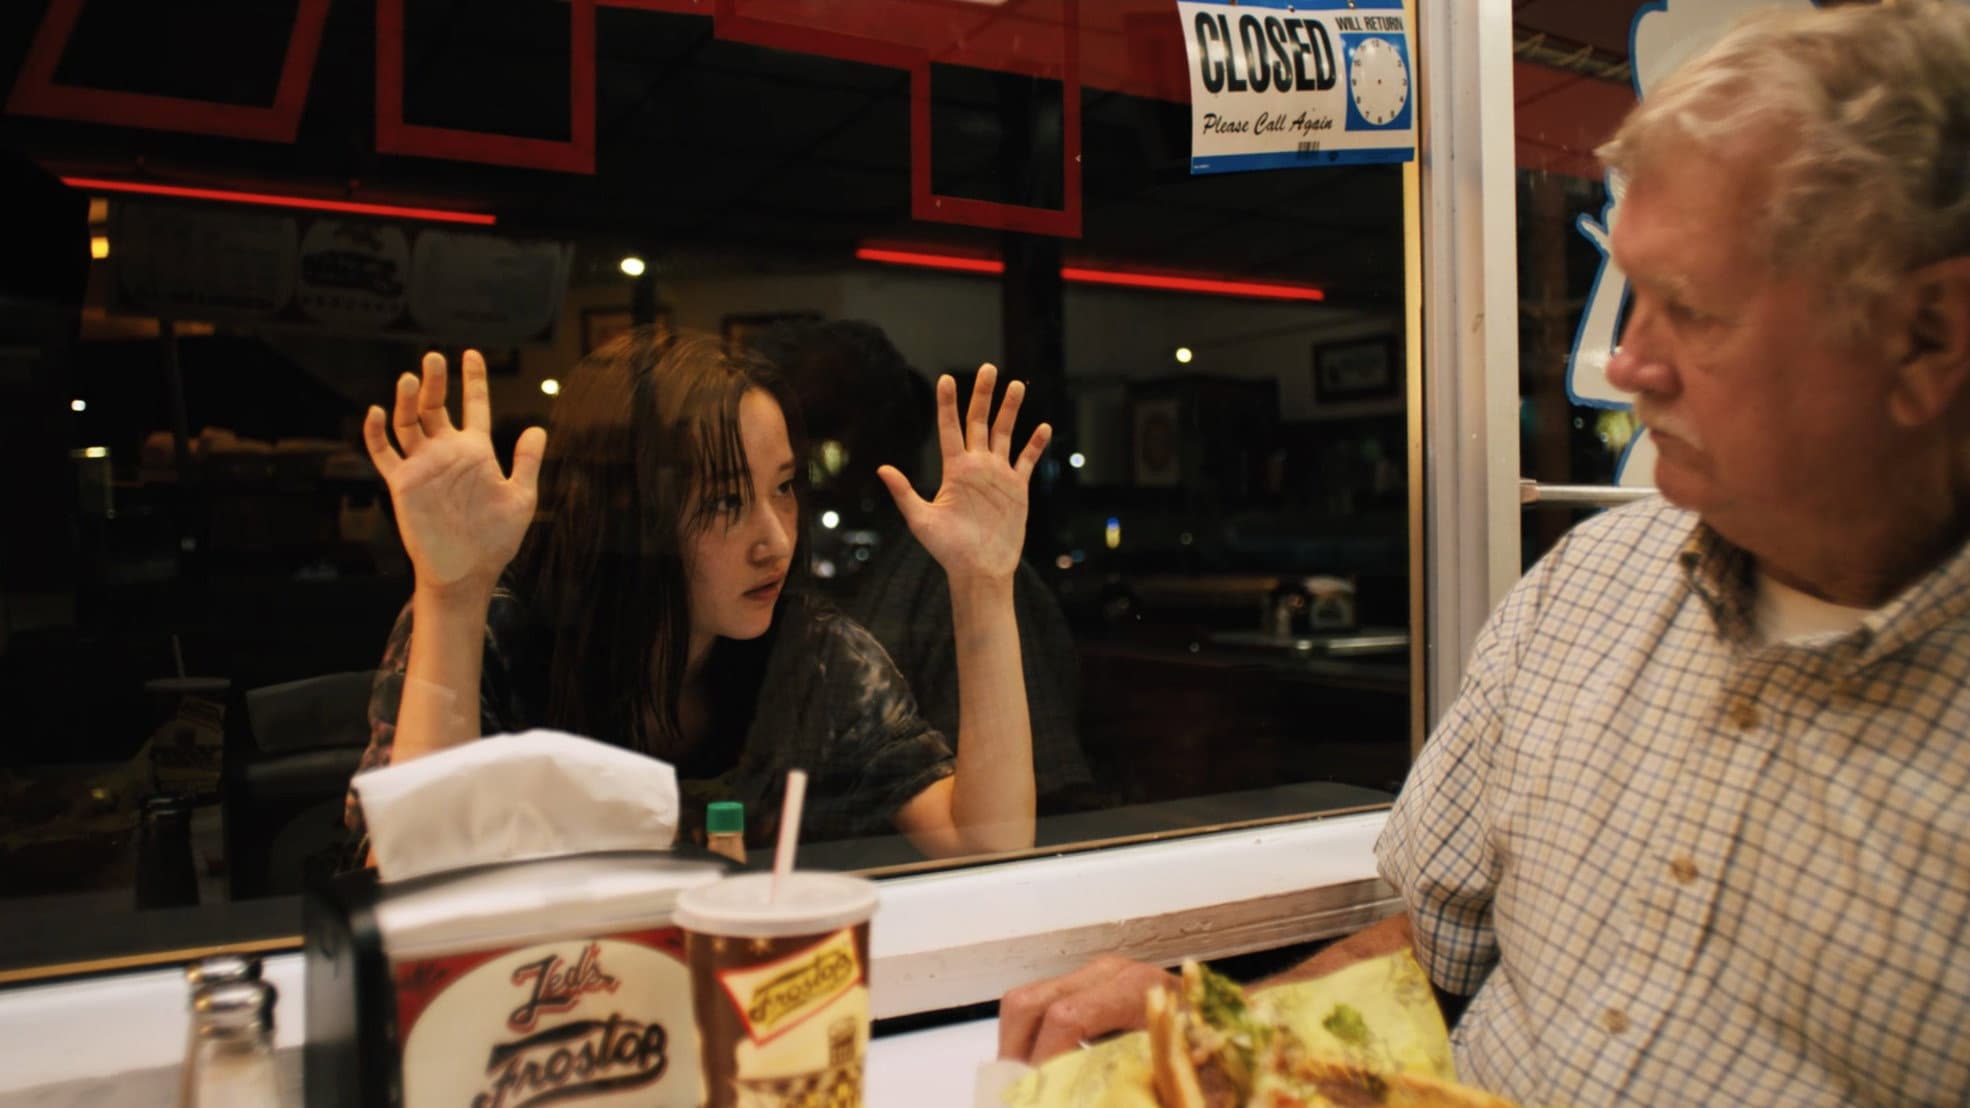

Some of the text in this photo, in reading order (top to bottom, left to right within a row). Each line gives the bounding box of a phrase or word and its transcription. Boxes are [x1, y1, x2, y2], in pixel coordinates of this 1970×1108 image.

[1195, 11, 1336, 93] CLOSED
[1334, 16, 1404, 31] WILL RETURN
[1203, 112, 1333, 136] Please Call Again
[748, 947, 854, 1028] Frostop
[471, 1013, 668, 1108] Frostop
